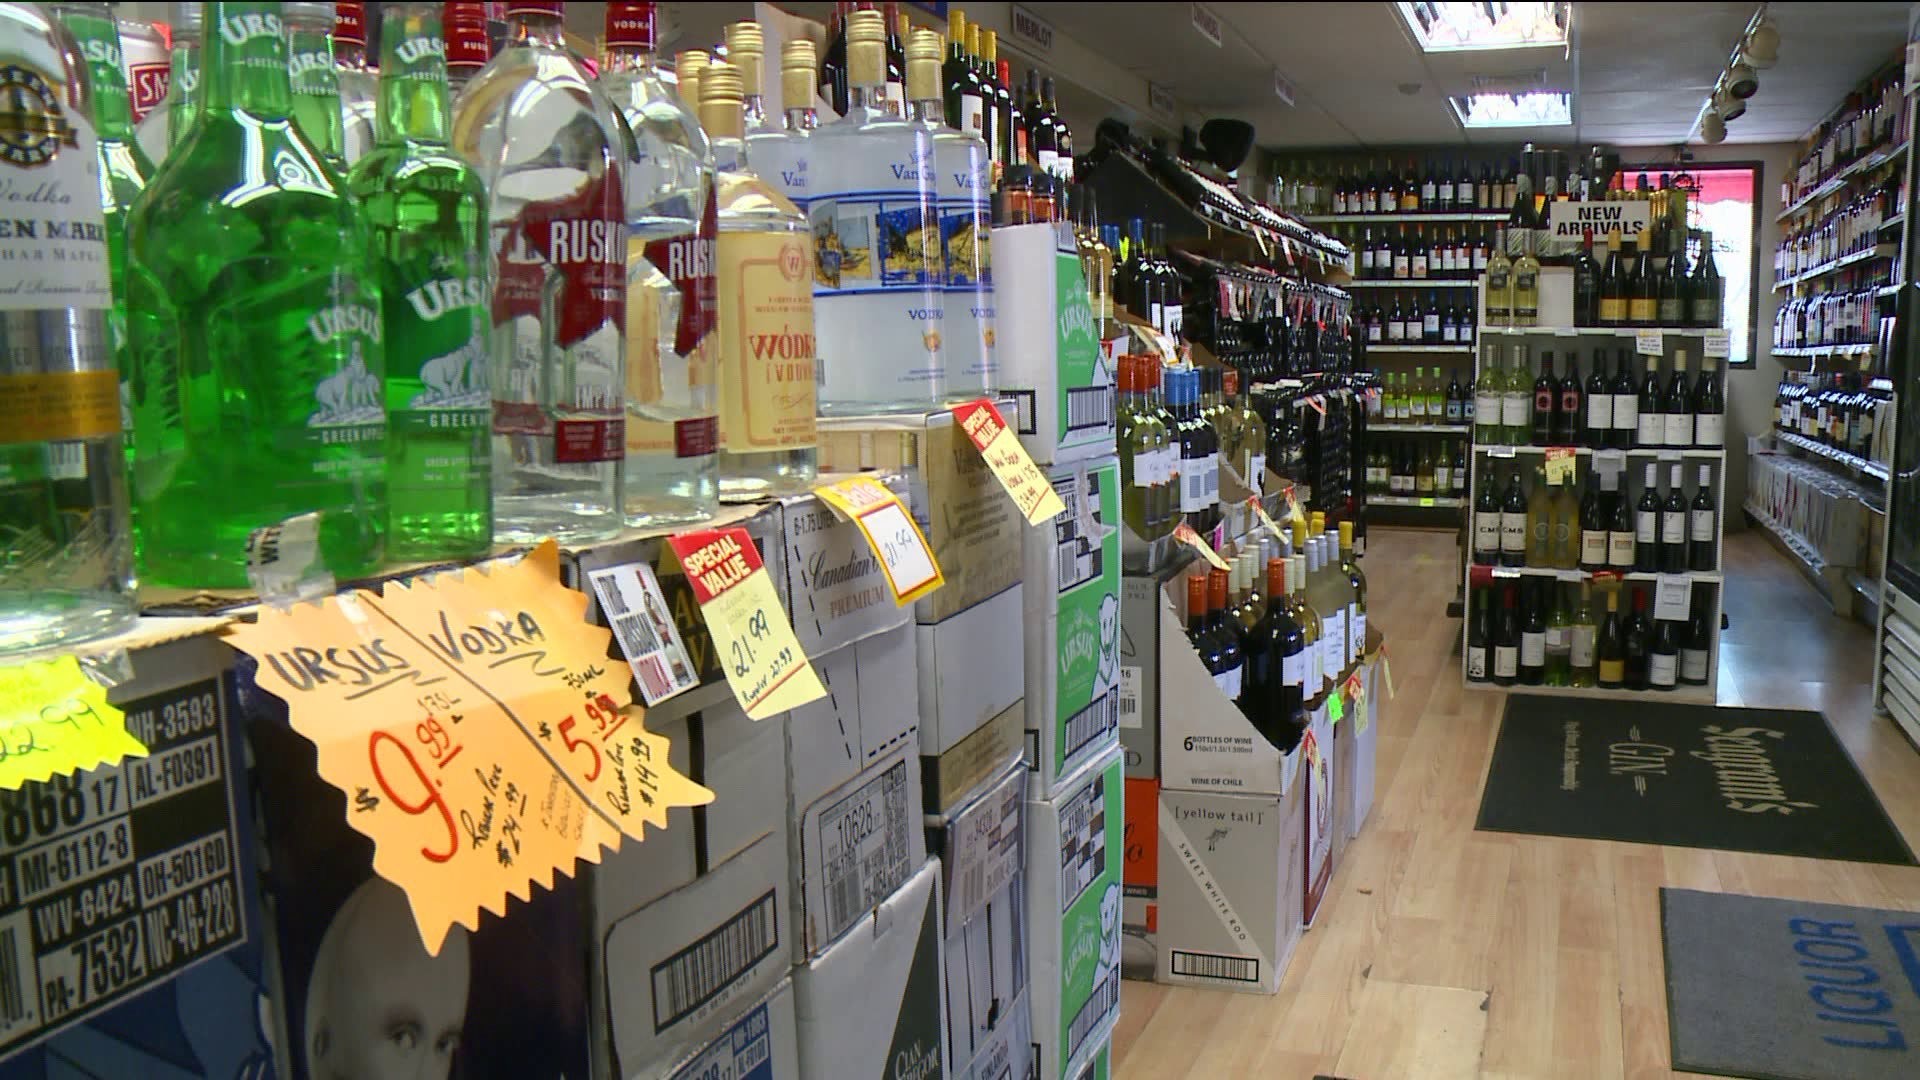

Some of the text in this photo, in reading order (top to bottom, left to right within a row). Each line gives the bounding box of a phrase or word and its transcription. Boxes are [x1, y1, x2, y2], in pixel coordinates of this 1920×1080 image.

[1015, 12, 1052, 49] MERLOT
[891, 164, 918, 181] Van
[1556, 220, 1644, 236] ARRIVALS
[1577, 206, 1623, 220] NEW
[683, 534, 742, 577] SPECIAL
[808, 549, 870, 591] Canadian
[700, 554, 751, 597] VALUE
[829, 585, 886, 619] PREMIUM
[429, 609, 546, 662] VODKA
[265, 638, 411, 691] URSUS
[1183, 735, 1194, 752] 6
[1193, 736, 1222, 745] BOTTLES
[1223, 737, 1233, 745] OF
[1190, 777, 1210, 785] WINE
[1222, 778, 1244, 786] CHILE
[1179, 842, 1246, 941] SWEET WHITE ROO
[1789, 916, 1908, 1053] LIQUOR
